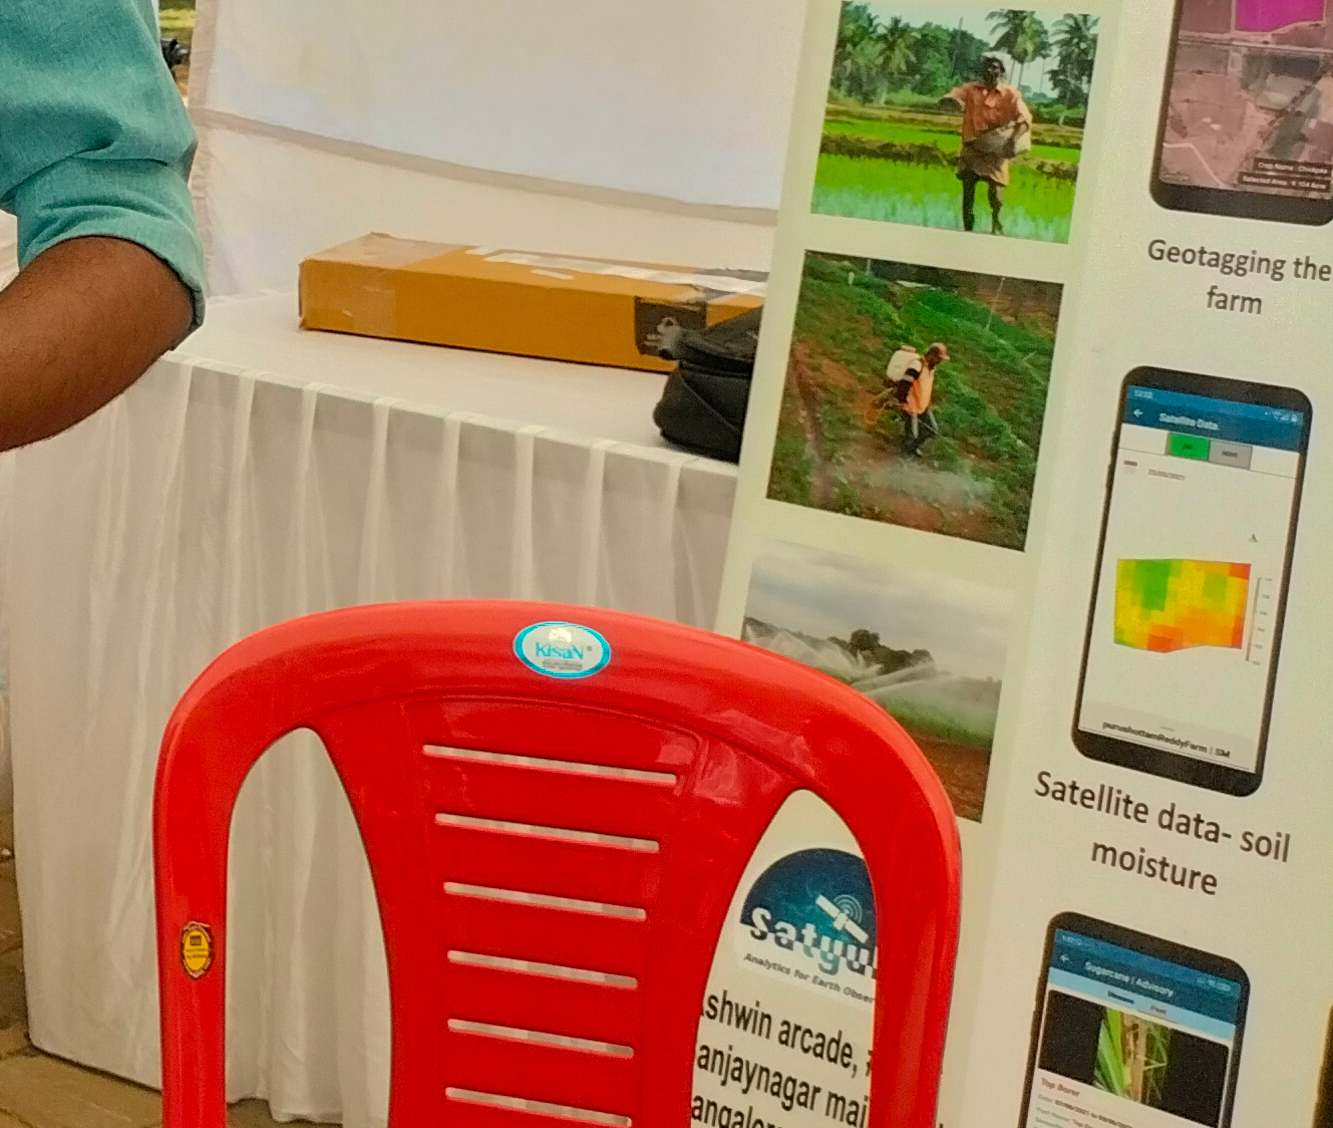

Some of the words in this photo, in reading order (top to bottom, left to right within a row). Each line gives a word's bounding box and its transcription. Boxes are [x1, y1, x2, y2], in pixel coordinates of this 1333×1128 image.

[1147, 238, 1286, 282] Geotagging
[1292, 255, 1332, 282] the
[1206, 284, 1263, 315] farm
[1034, 770, 1150, 824] Satellite
[1157, 801, 1233, 844] data-
[1239, 829, 1291, 863] soil
[1091, 841, 1218, 896] moisture
[743, 953, 791, 975] Analytics
[794, 969, 810, 981] for
[811, 975, 841, 992] Earth
[749, 906, 877, 980] Satyu
[702, 989, 773, 1040] shwin
[778, 1019, 858, 1078] arcade,
[696, 1044, 822, 1112] anjaynagar
[825, 1090, 870, 1128] mai
